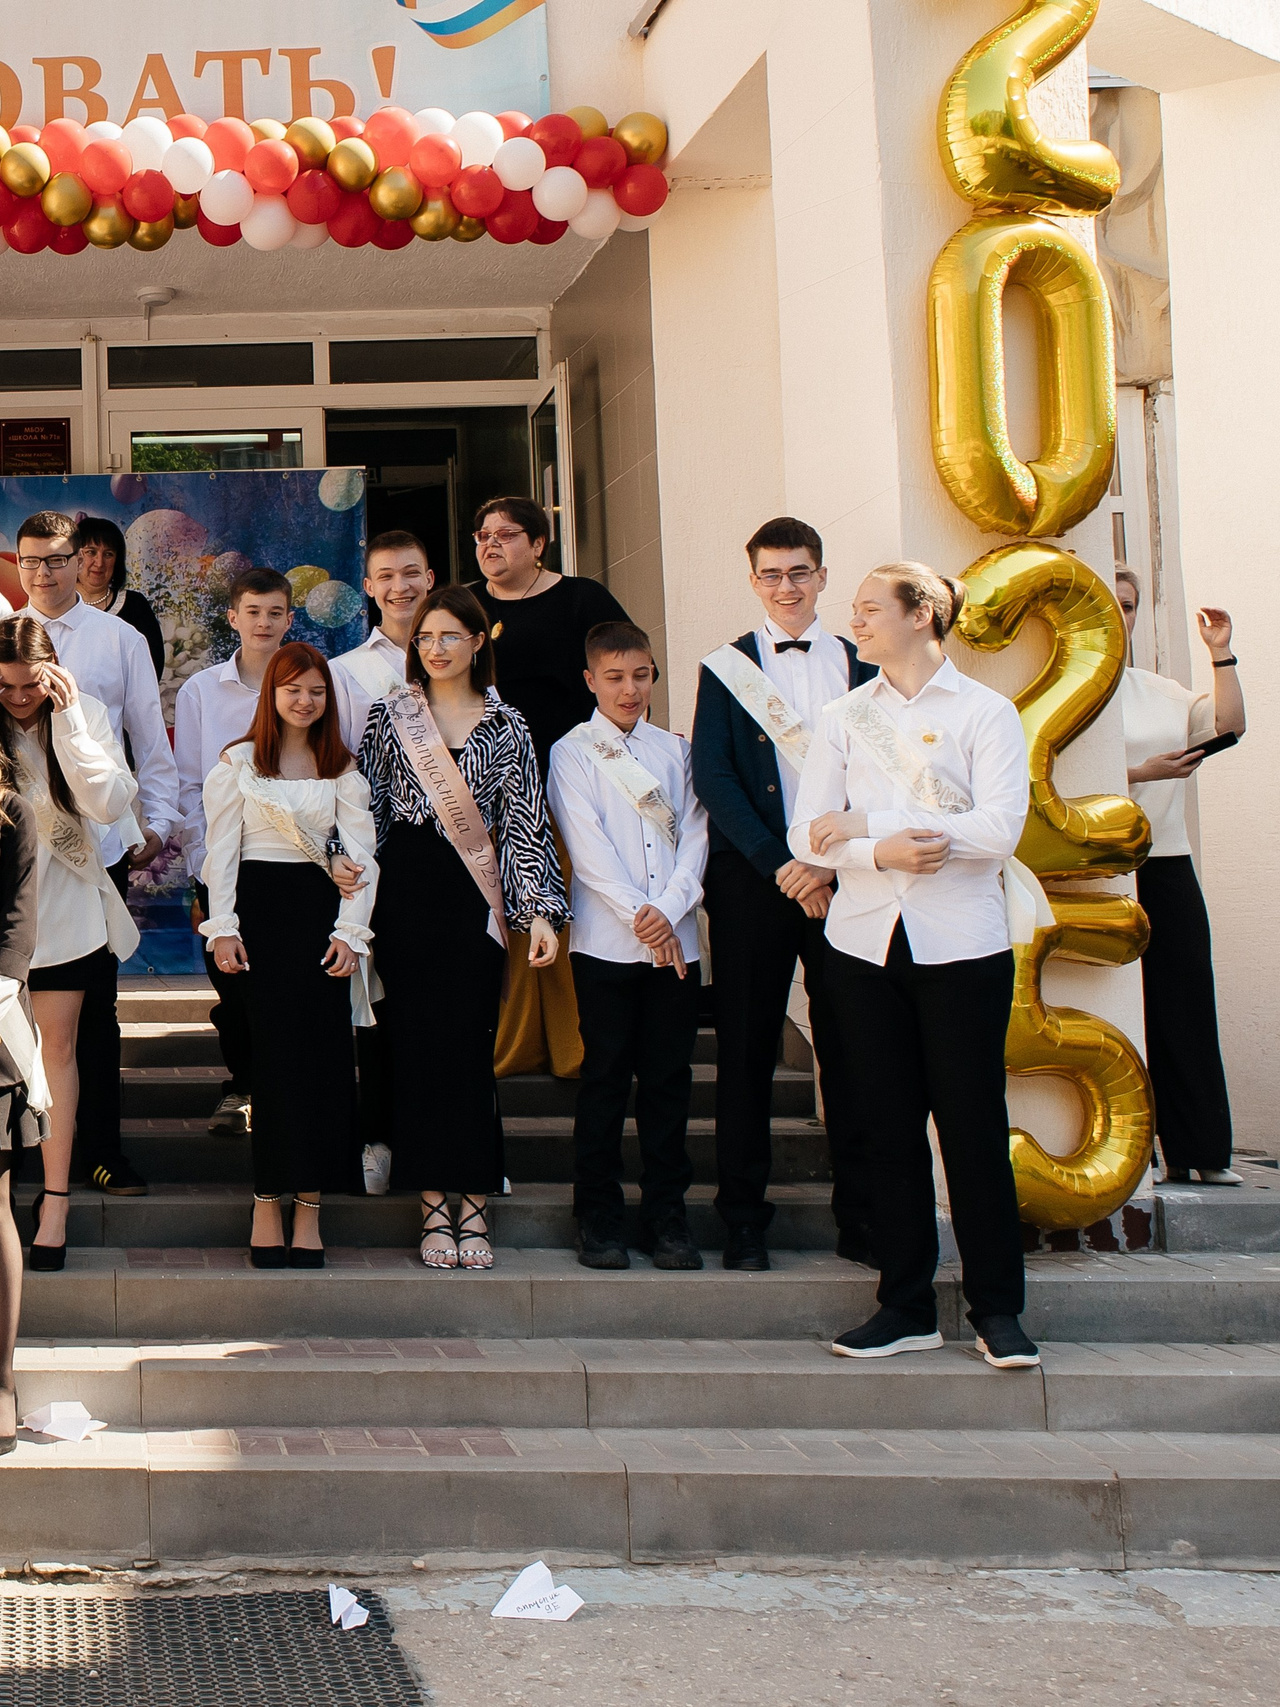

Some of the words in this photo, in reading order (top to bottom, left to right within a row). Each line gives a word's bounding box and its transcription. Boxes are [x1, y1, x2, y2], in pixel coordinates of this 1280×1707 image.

[50, 826, 94, 868] 2025
[406, 720, 471, 836] Выпускница
[466, 843, 500, 889] 2025
